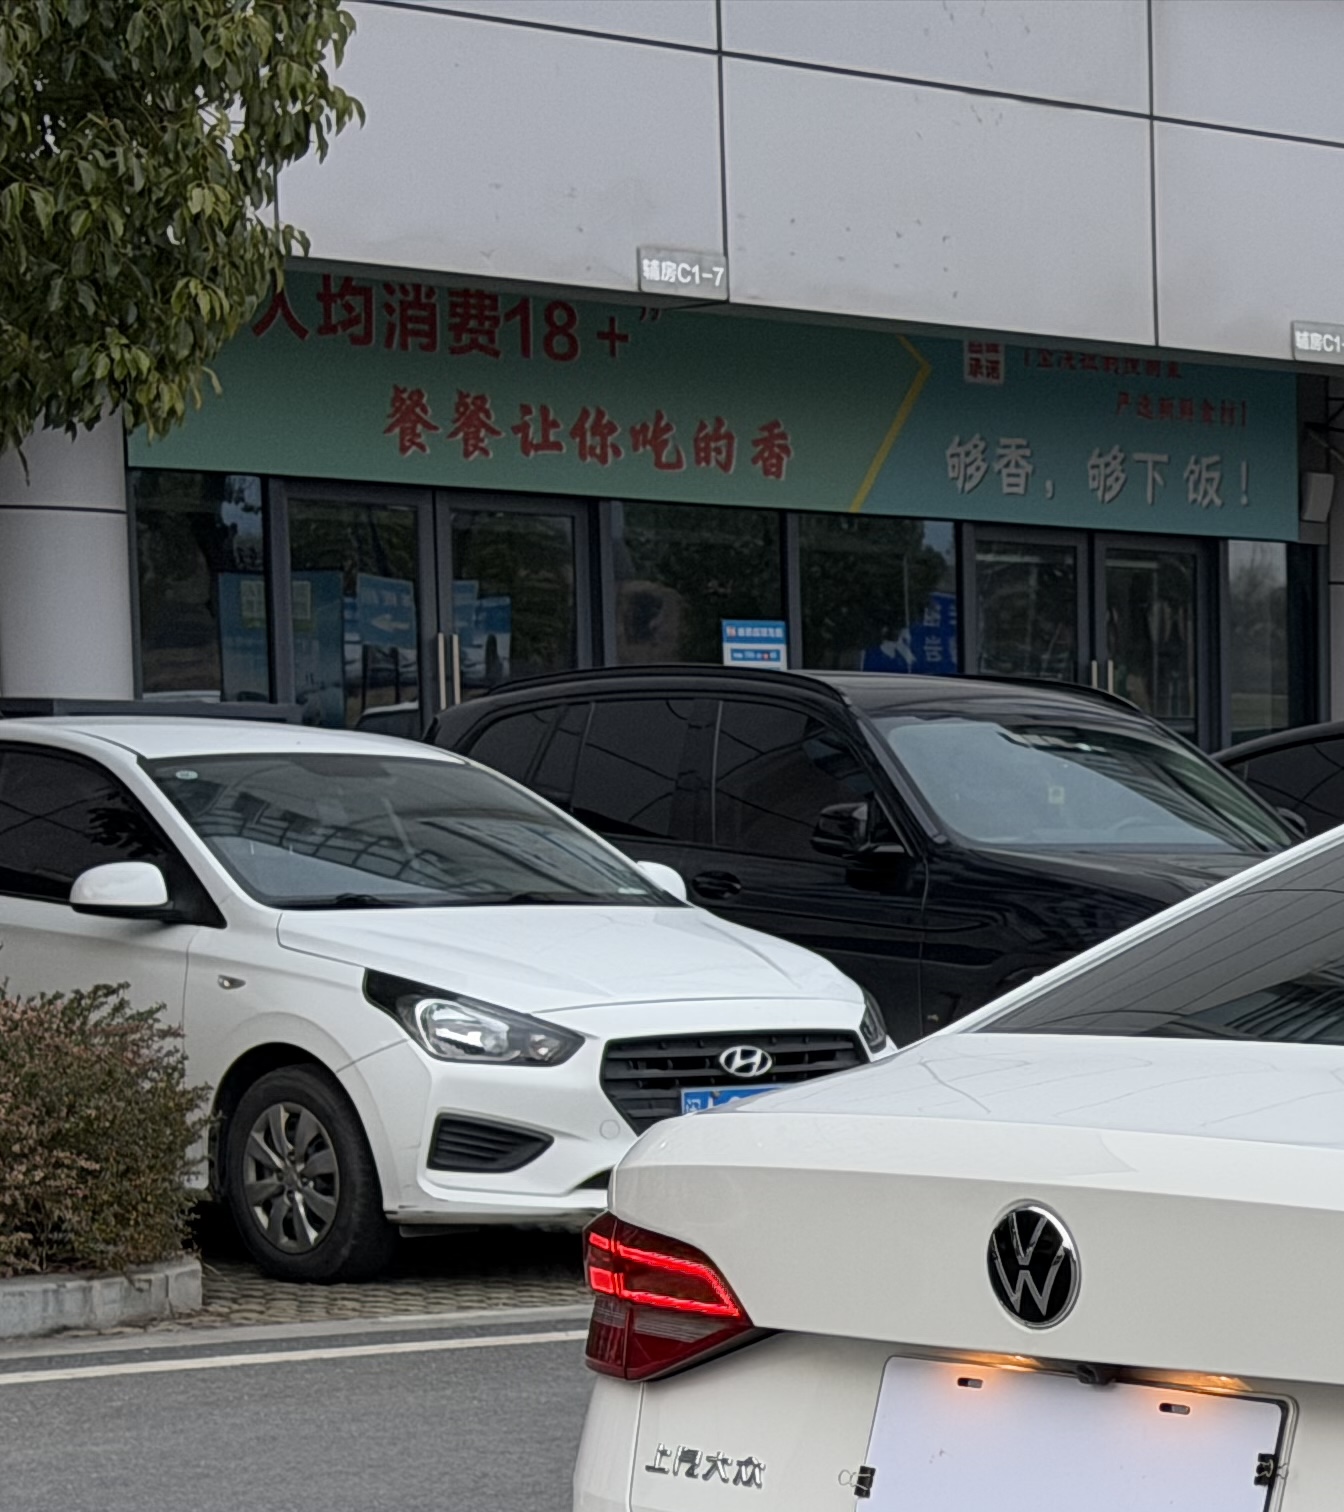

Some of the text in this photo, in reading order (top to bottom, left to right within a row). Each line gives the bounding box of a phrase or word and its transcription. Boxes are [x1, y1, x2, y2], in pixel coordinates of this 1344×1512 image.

[384, 384, 795, 481] 餐餐让你吃的香
[644, 1442, 767, 1490] 上汽大众
